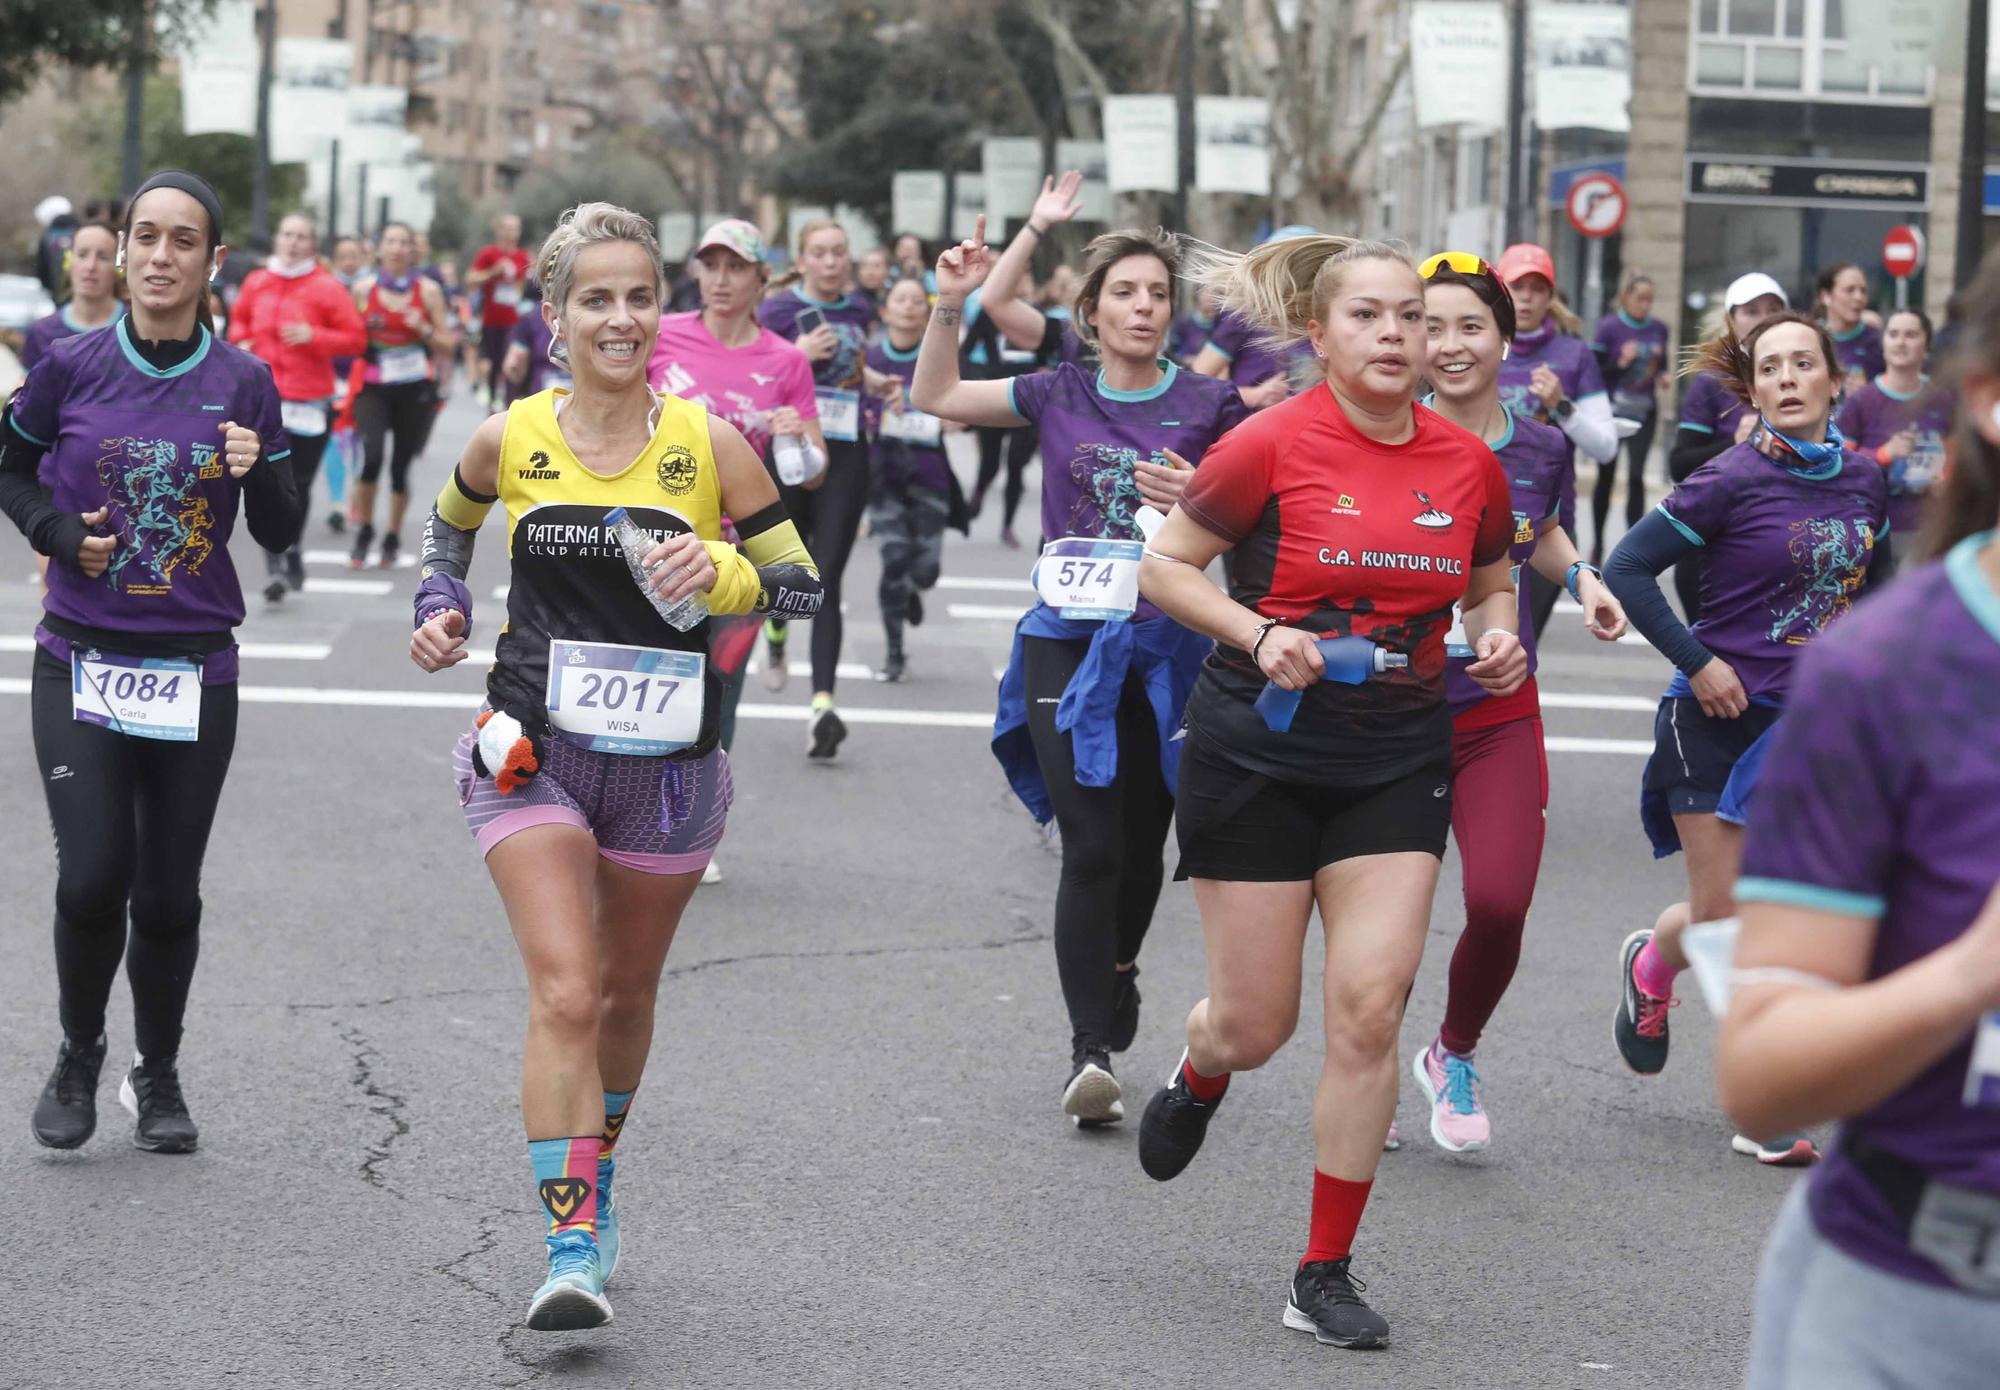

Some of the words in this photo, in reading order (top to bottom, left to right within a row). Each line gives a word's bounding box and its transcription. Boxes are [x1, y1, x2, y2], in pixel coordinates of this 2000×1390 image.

[191, 450, 219, 466] 10K
[201, 466, 222, 478] FEM
[518, 469, 560, 480] VIATOR
[1340, 496, 1352, 506] IN
[527, 524, 599, 544] PATERNA
[528, 545, 567, 555] CLUB
[1318, 548, 1355, 566] C.A.
[1361, 551, 1431, 571] KUNTUR
[1436, 557, 1462, 575] VLC
[1058, 561, 1114, 588] 574
[96, 669, 180, 704] 1084
[576, 673, 680, 714] 2017
[119, 707, 147, 720] Carla
[607, 719, 640, 733] WISA
